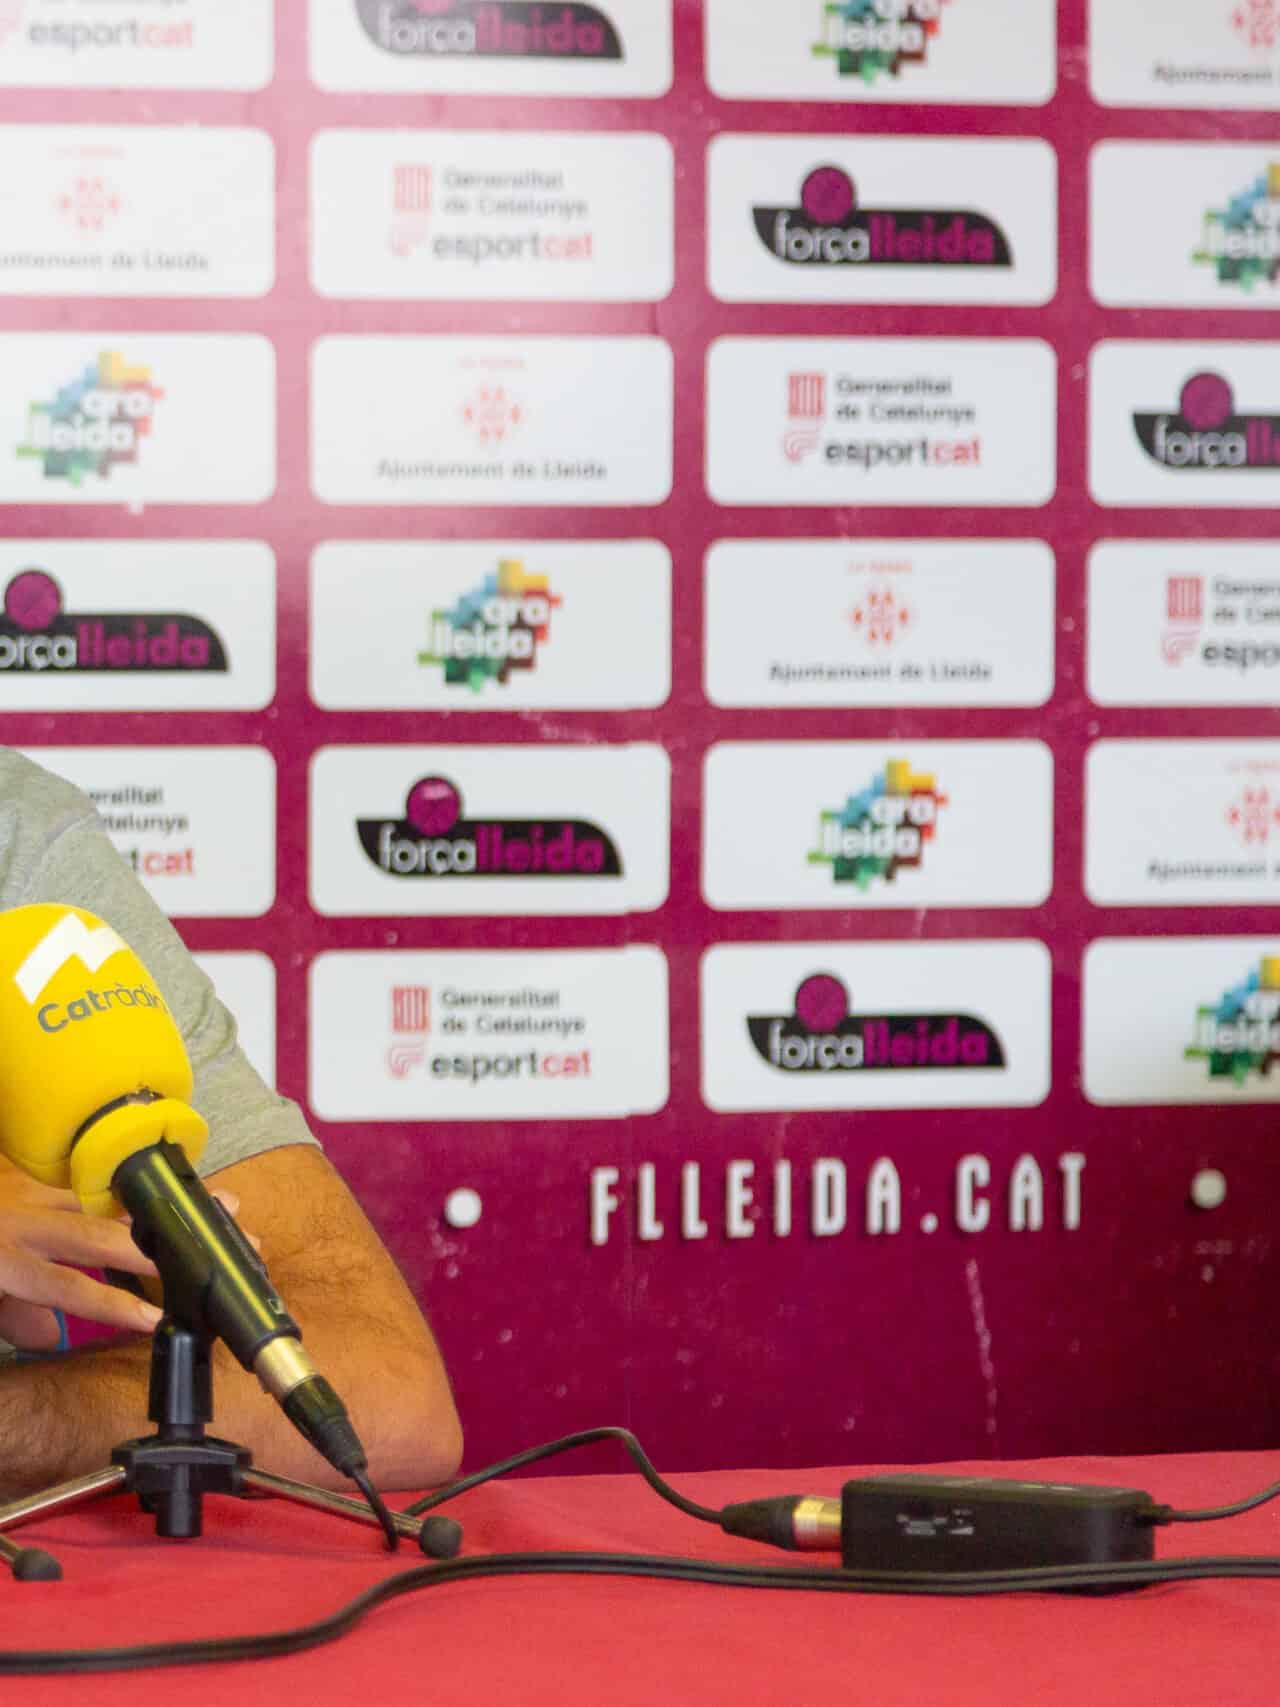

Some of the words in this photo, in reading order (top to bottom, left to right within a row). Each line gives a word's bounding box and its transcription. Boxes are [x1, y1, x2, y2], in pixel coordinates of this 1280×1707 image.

[28, 18, 194, 53] esportcat
[433, 230, 593, 264] esportcat
[825, 436, 981, 469] esportcat
[441, 987, 560, 1008] Generalitat
[442, 1015, 465, 1033] de
[476, 1014, 586, 1037] Catalunya
[431, 1049, 591, 1085] esportcat
[590, 1151, 1087, 1246] FLLEIDA.CAT
